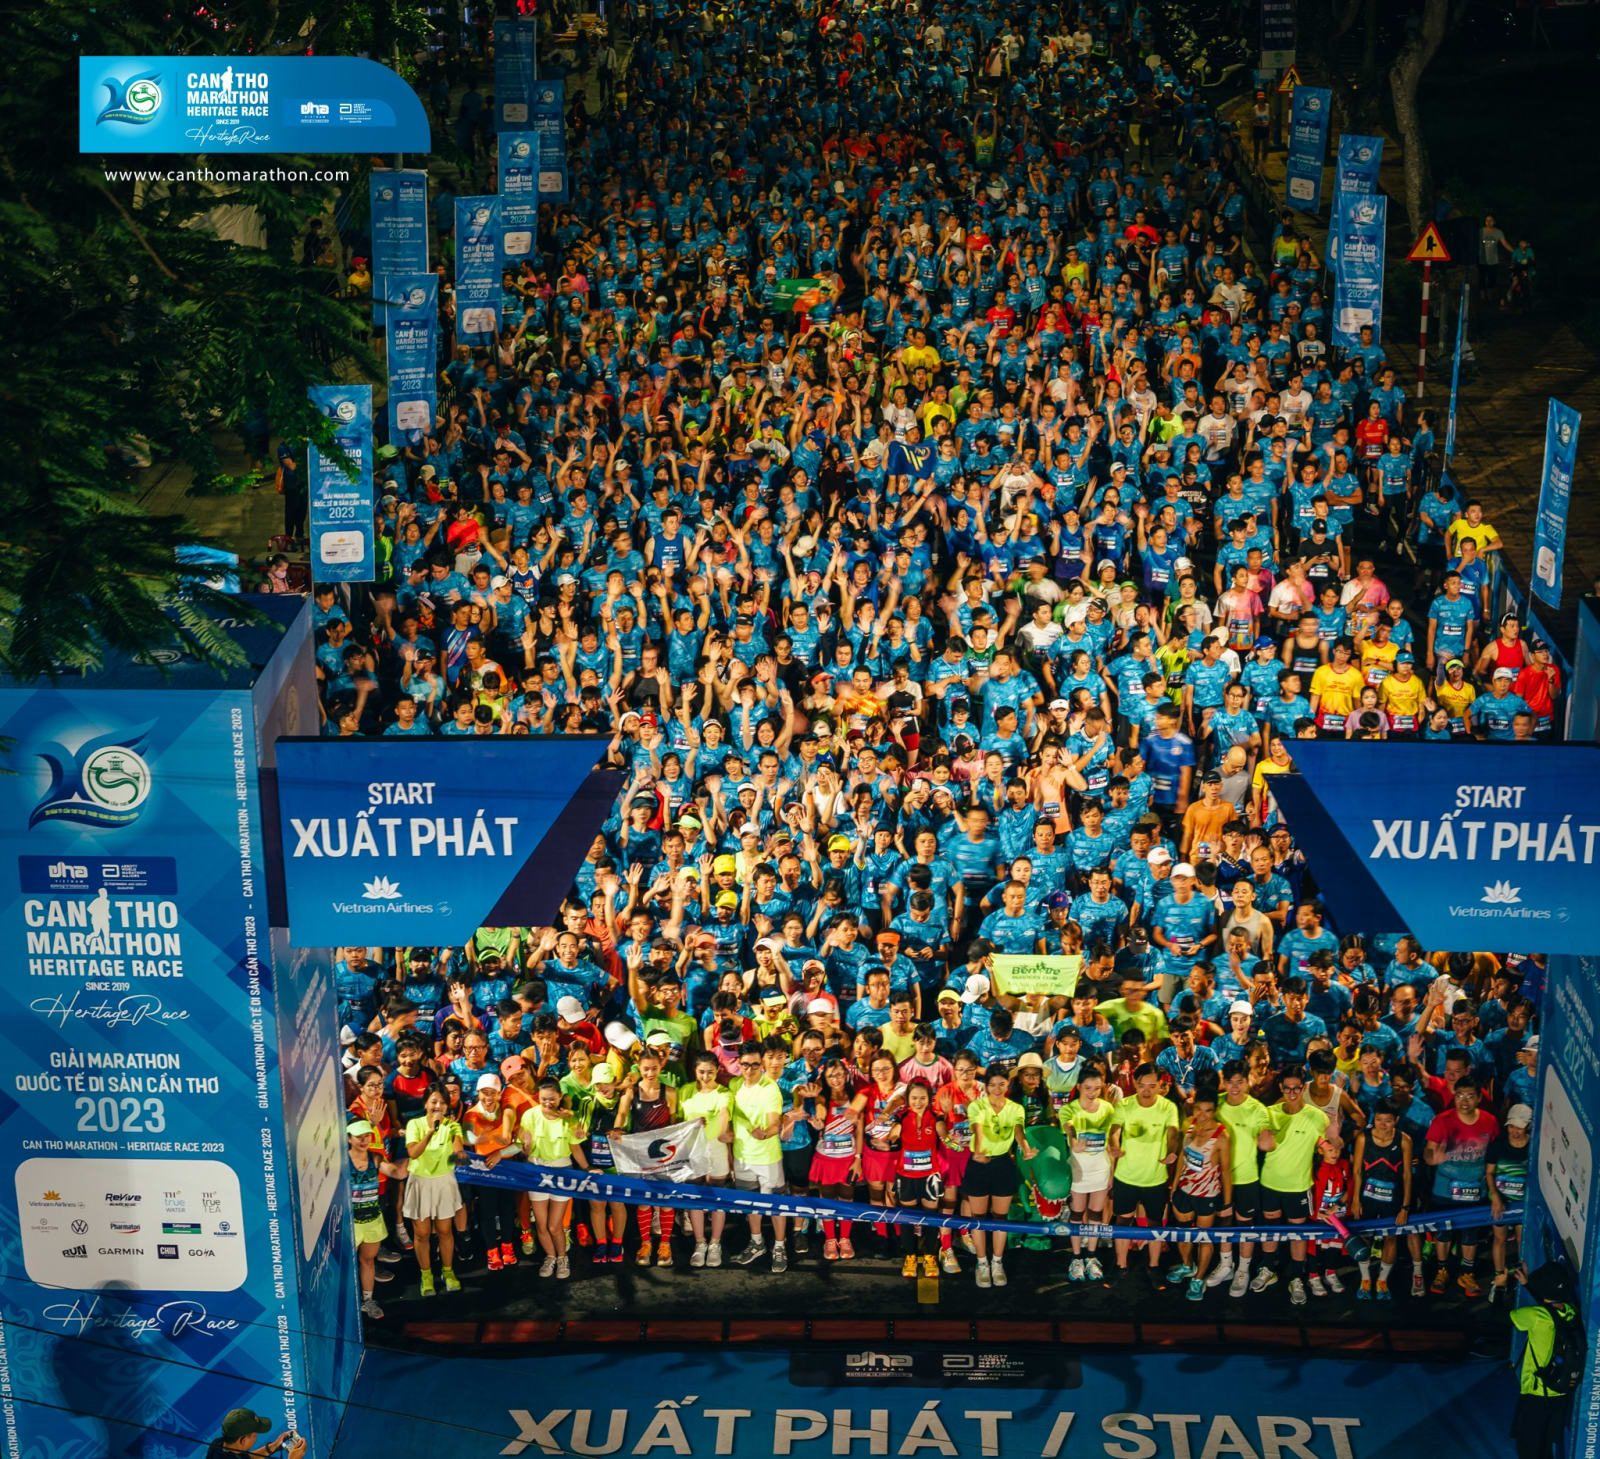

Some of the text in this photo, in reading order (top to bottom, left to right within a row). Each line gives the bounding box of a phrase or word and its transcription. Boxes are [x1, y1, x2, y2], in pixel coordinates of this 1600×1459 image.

[510, 216, 527, 224] 2023
[469, 289, 489, 299] 2023
[402, 379, 421, 390] 2023
[329, 507, 355, 518] 2023
[231, 708, 254, 897] CAN THO MARATHON HERITAGE RACE 2023
[368, 782, 435, 805] START
[1456, 786, 1526, 809] START
[290, 806, 518, 857] XUẤT PHÁT
[1370, 810, 1600, 864] XUẤT PHÁT
[24, 900, 179, 929] CAN THO
[27, 931, 181, 956] MARATHON
[29, 958, 183, 977] HERITAGE RACE
[85, 982, 130, 991] SINCE 2019
[30, 990, 190, 1028] Heritage Race
[245, 916, 269, 1109] GIẢI MARATHON QUỐC TẾ DI SẢN CẦN THƠ 2023
[50, 1048, 179, 1069] GIẢI MARATHON
[16, 1071, 219, 1093] QUỐC TẾ DI SẢN CẦN THƠ
[75, 1098, 165, 1133] 2023
[23, 1140, 42, 1150] CAN
[44, 1140, 63, 1150] THO
[64, 1141, 118, 1151] MARATHON
[127, 1141, 172, 1151] HERITAGE
[175, 1142, 199, 1152] RACE
[202, 1142, 224, 1152] 2023
[105, 1194, 142, 1202] ReVive
[262, 1128, 285, 1298] CAN THO MARATHON HERITAGE RACE 2023
[62, 1245, 87, 1255] RUN
[43, 1296, 160, 1339] Heritage
[156, 1300, 239, 1336] Race
[277, 1315, 288, 1334] 2023
[279, 1335, 289, 1350] THƠ
[279, 1352, 292, 1371] CẦN
[282, 1373, 294, 1387] SẢN
[500, 1394, 751, 1456] XUẤT
[772, 1400, 1013, 1458] PHÁT
[1102, 1413, 1362, 1459] START
